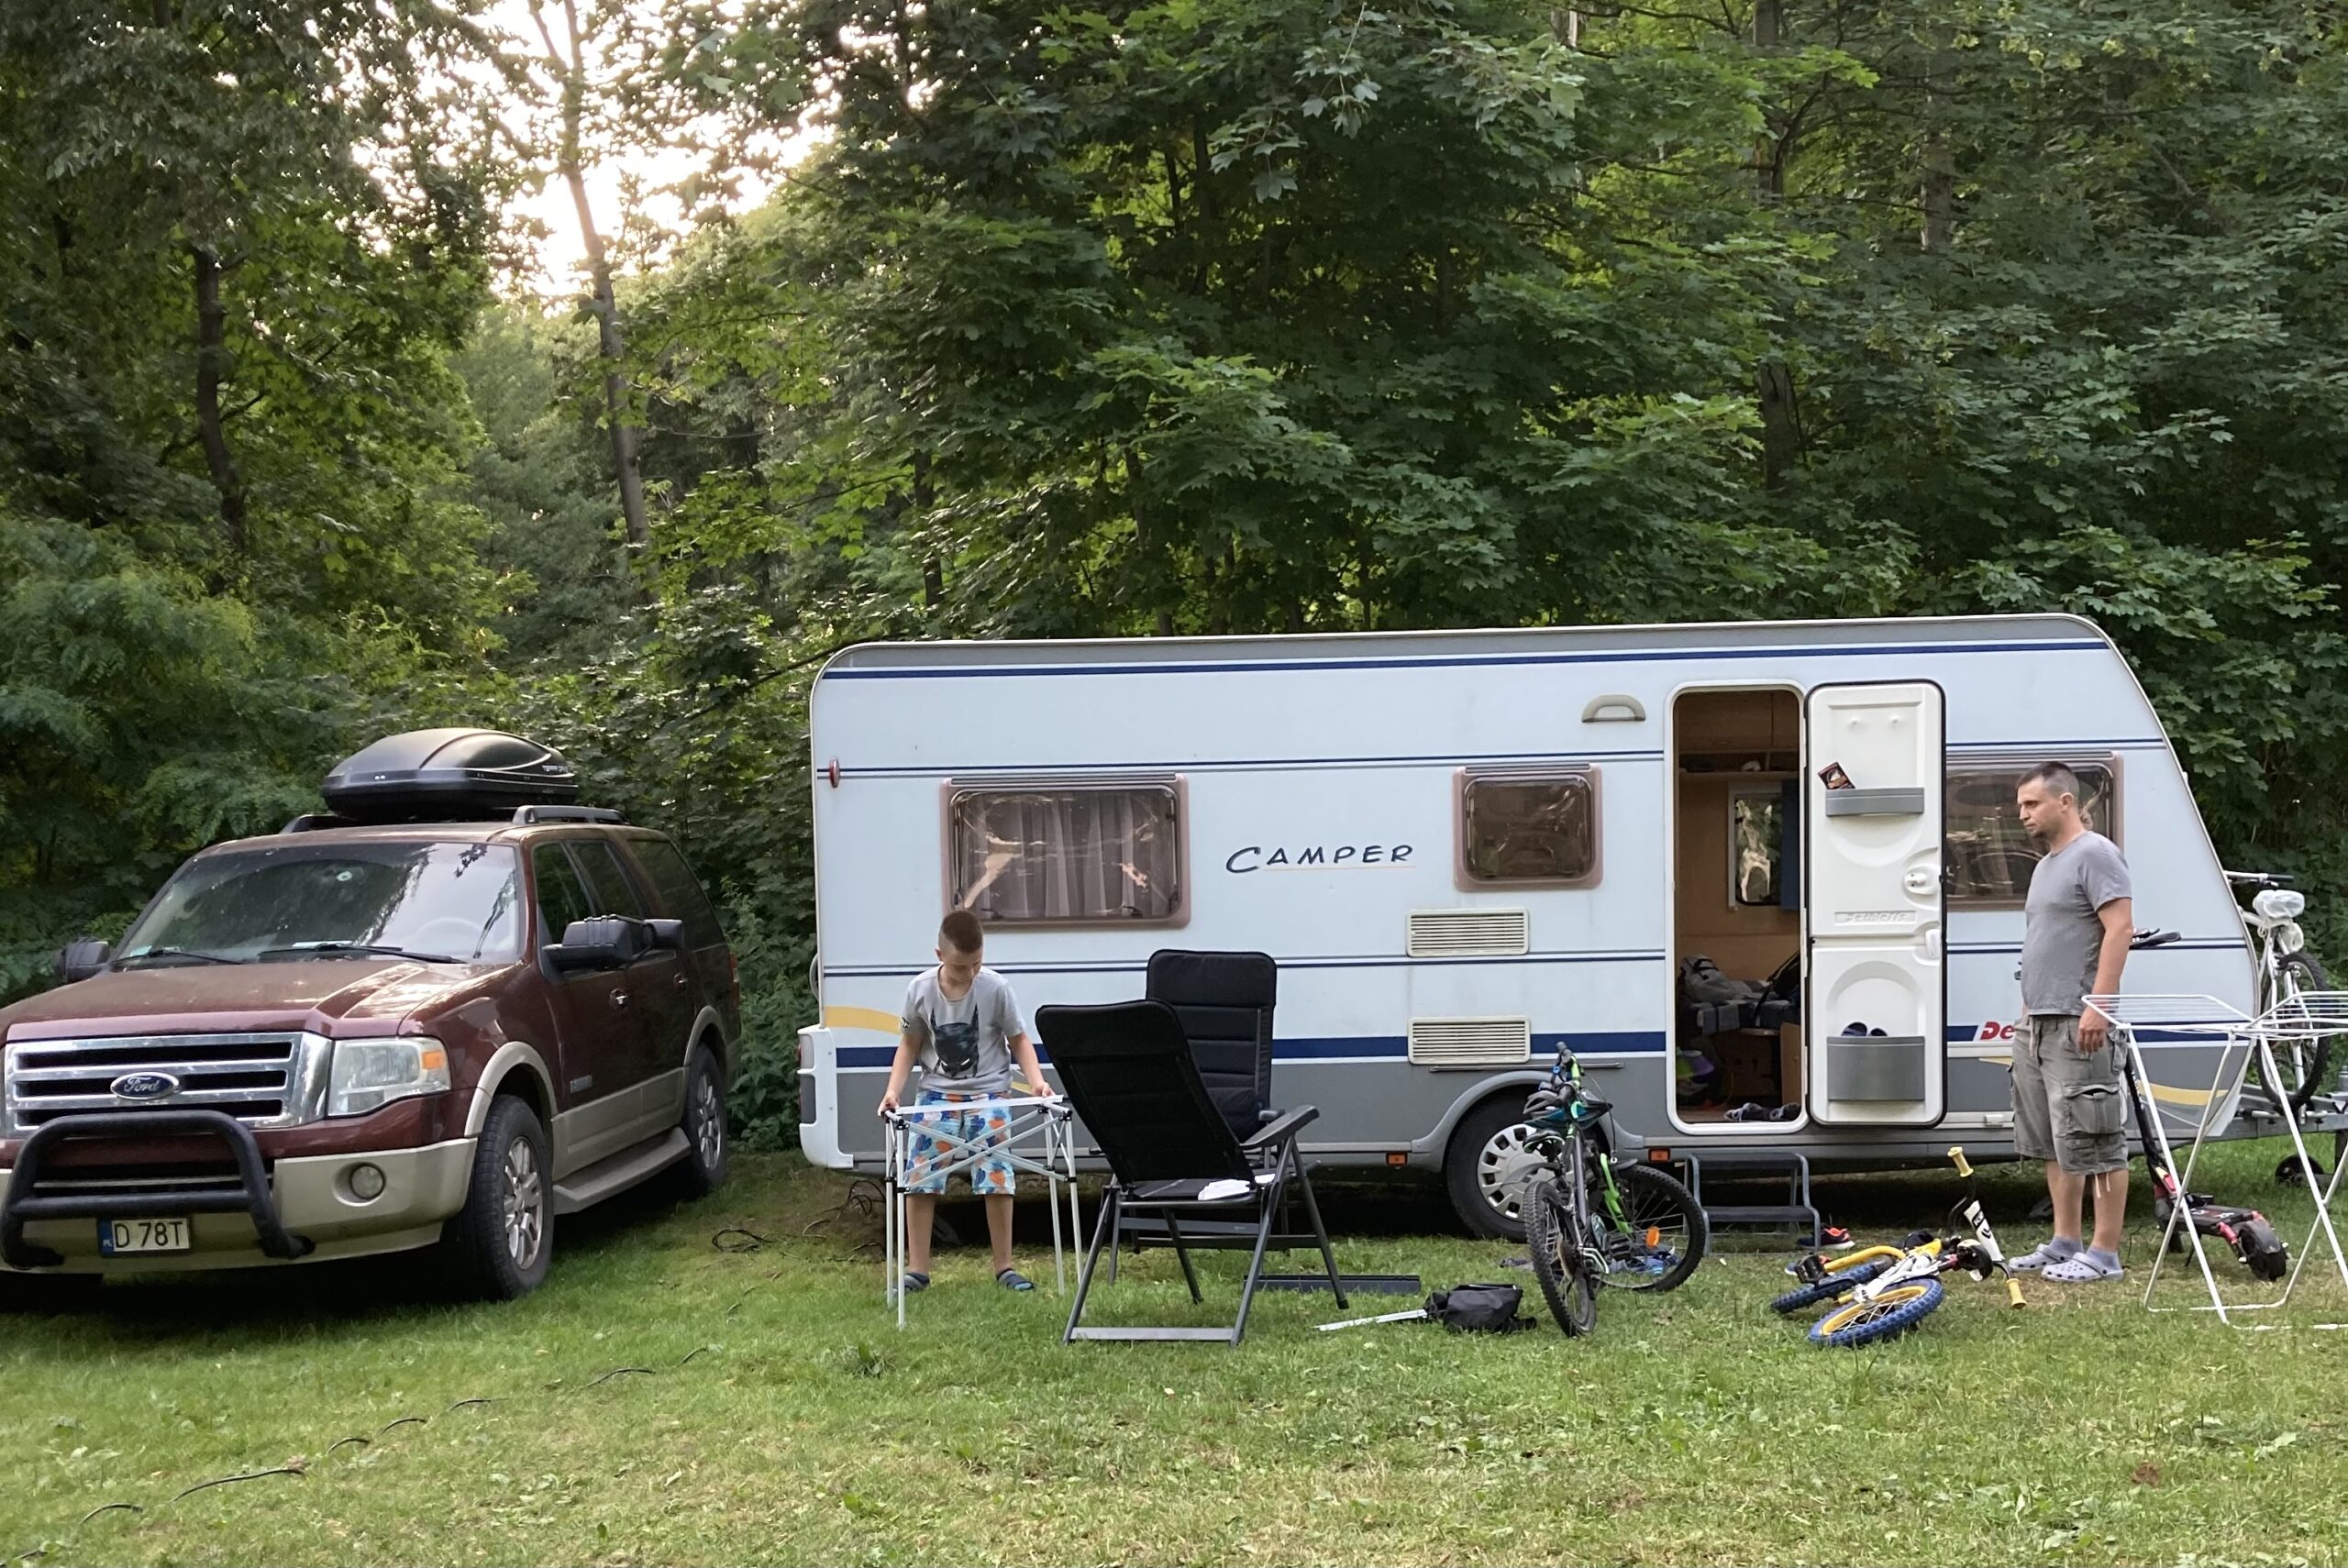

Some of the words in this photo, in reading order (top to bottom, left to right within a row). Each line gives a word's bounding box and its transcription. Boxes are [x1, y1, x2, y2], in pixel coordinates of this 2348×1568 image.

[1225, 844, 1413, 873] CAMPER
[124, 1077, 161, 1092] Ford
[115, 1222, 130, 1248] D
[138, 1220, 183, 1247] 78T
